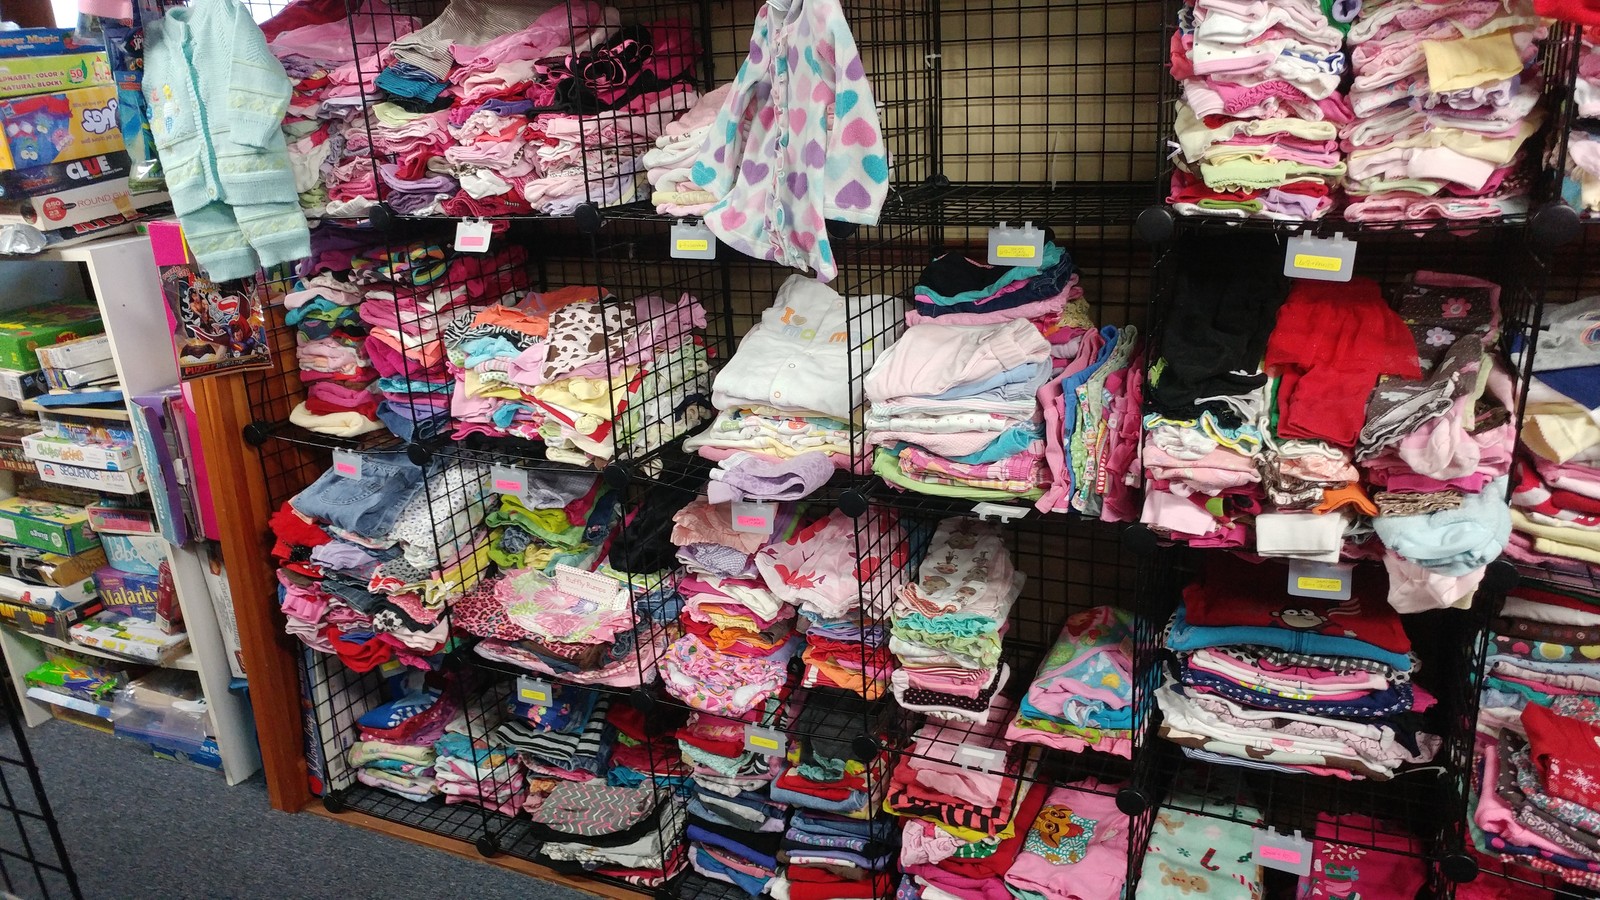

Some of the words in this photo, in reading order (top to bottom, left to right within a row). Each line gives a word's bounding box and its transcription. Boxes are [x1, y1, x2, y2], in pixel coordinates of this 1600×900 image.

[26, 34, 59, 44] Magic
[70, 69, 83, 78] 50
[66, 155, 110, 180] CLUE
[77, 194, 111, 207] ROUND
[60, 465, 99, 480] SEQUENCE
